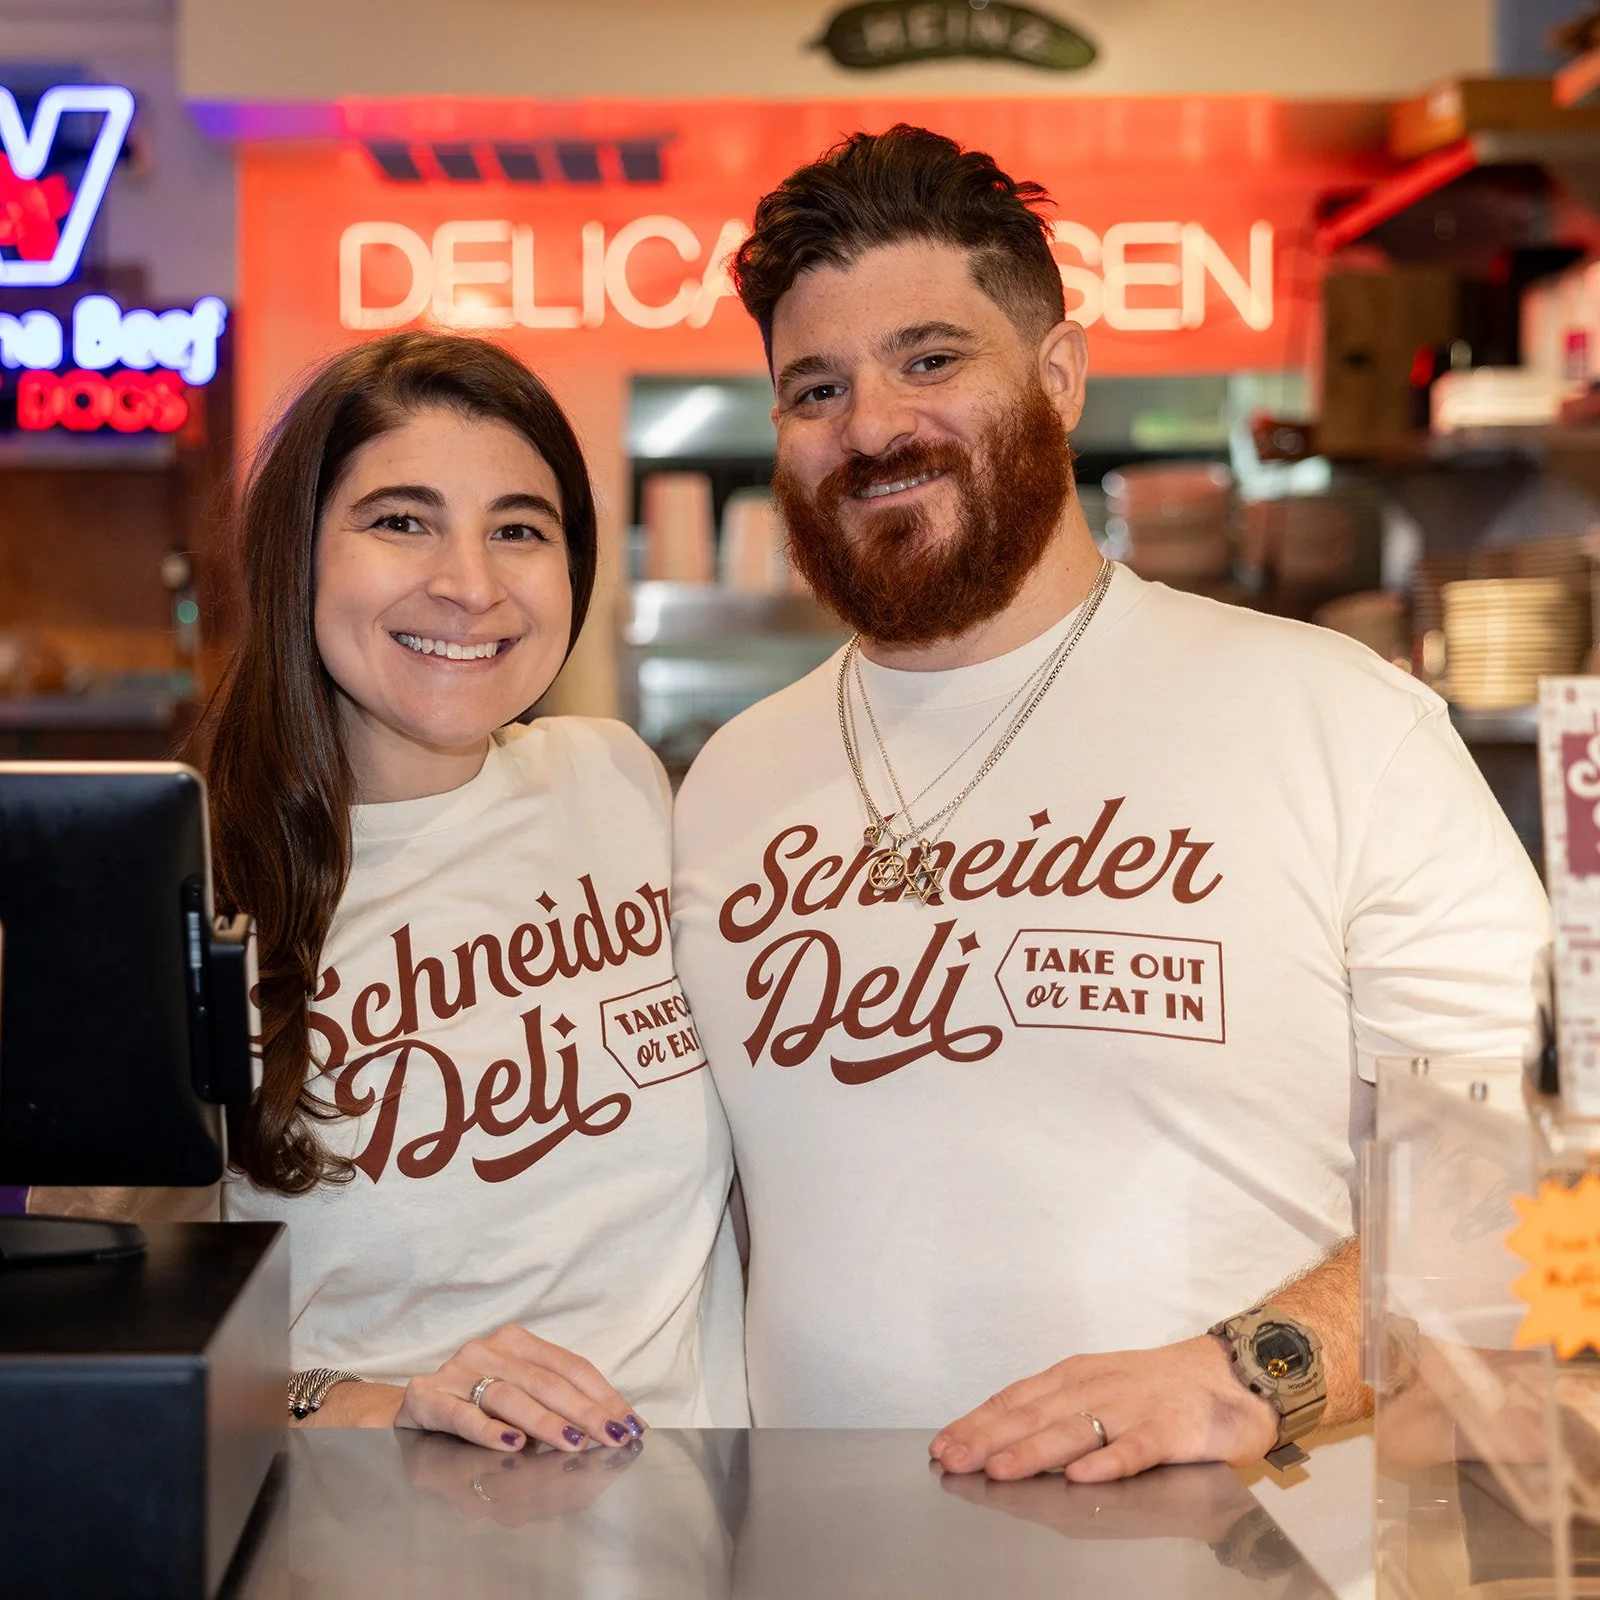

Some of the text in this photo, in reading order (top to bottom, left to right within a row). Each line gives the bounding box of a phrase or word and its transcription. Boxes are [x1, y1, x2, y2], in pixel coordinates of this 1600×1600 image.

[338, 215, 1275, 331] DELICASEN
[17, 368, 190, 433] DOGS
[718, 796, 1224, 943] Schneider
[743, 918, 1003, 1085] Deli
[1023, 946, 1206, 985] TAKE OUT
[1025, 981, 1205, 1022] or EAT IN
[334, 1004, 632, 1185] Deli
[636, 1038, 667, 1068] or
